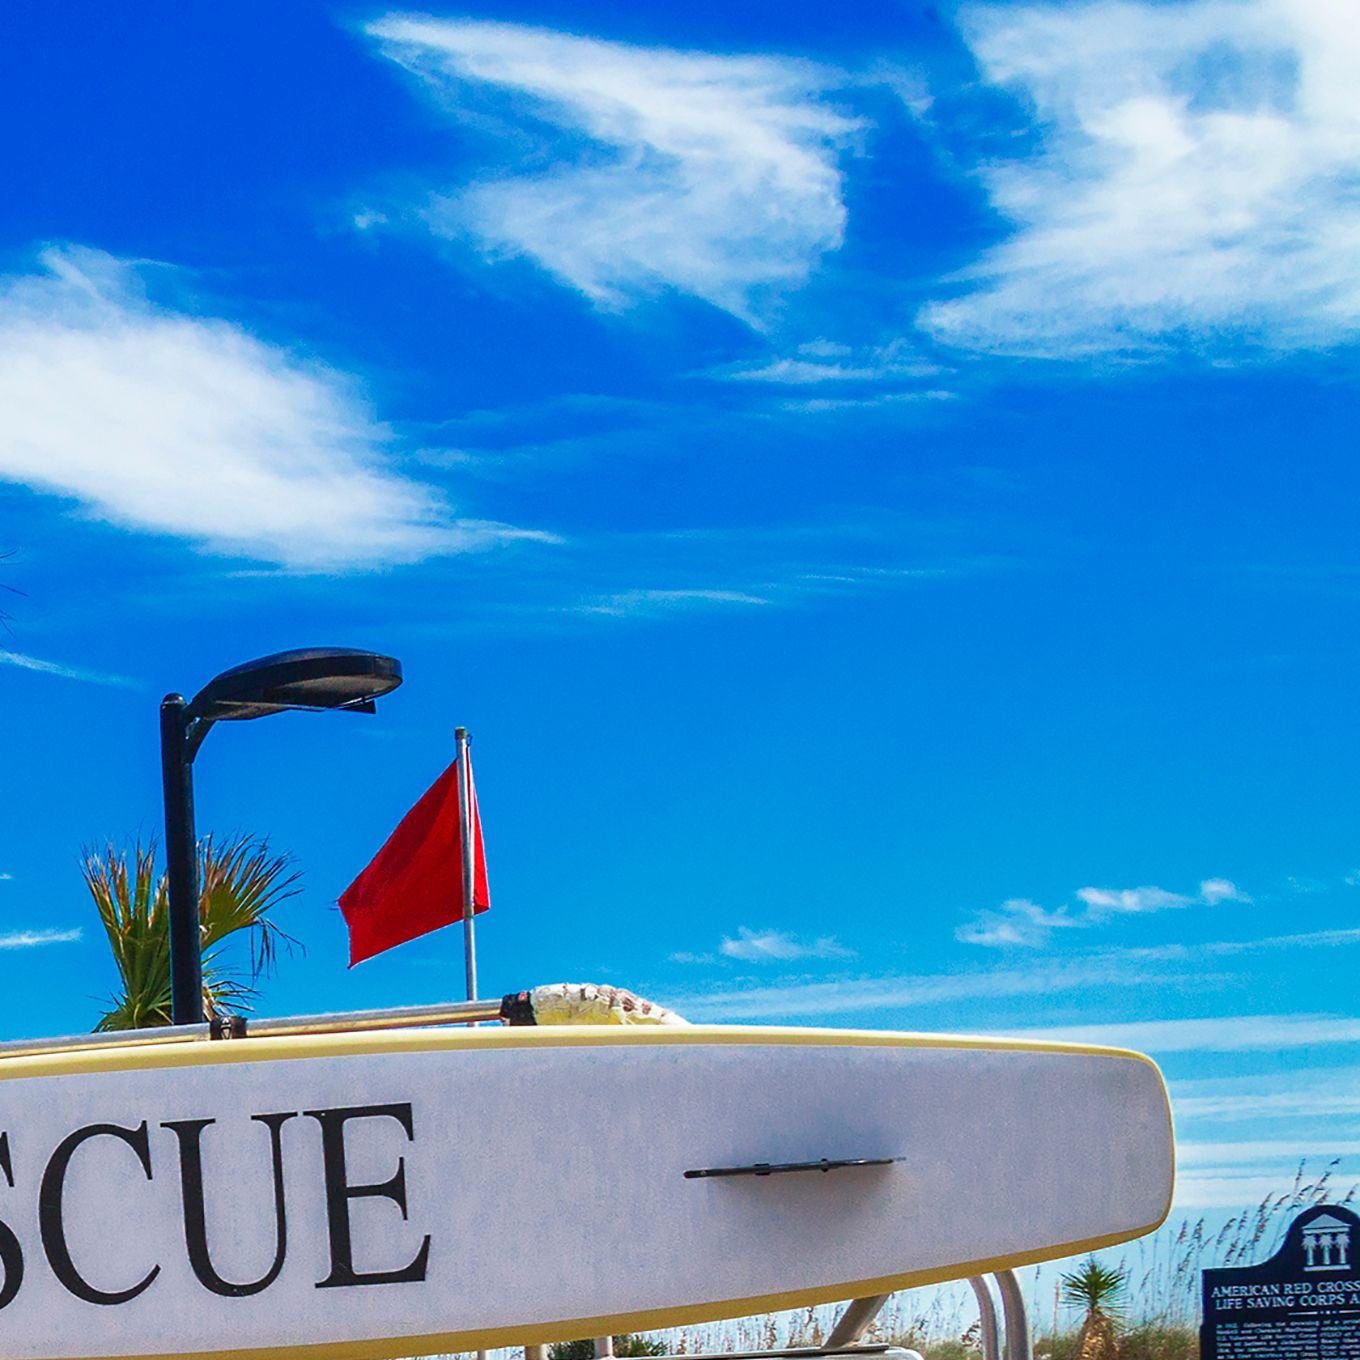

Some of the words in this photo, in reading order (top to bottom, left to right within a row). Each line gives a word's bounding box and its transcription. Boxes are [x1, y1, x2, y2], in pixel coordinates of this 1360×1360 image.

[1211, 1283, 1280, 1299] AMERICAN
[1284, 1282, 1312, 1296] RED
[1317, 1280, 1360, 1293] CROSS
[1215, 1298, 1243, 1310] LIFE
[1246, 1296, 1295, 1309] SAVING
[1299, 1294, 1346, 1307] CORPS
